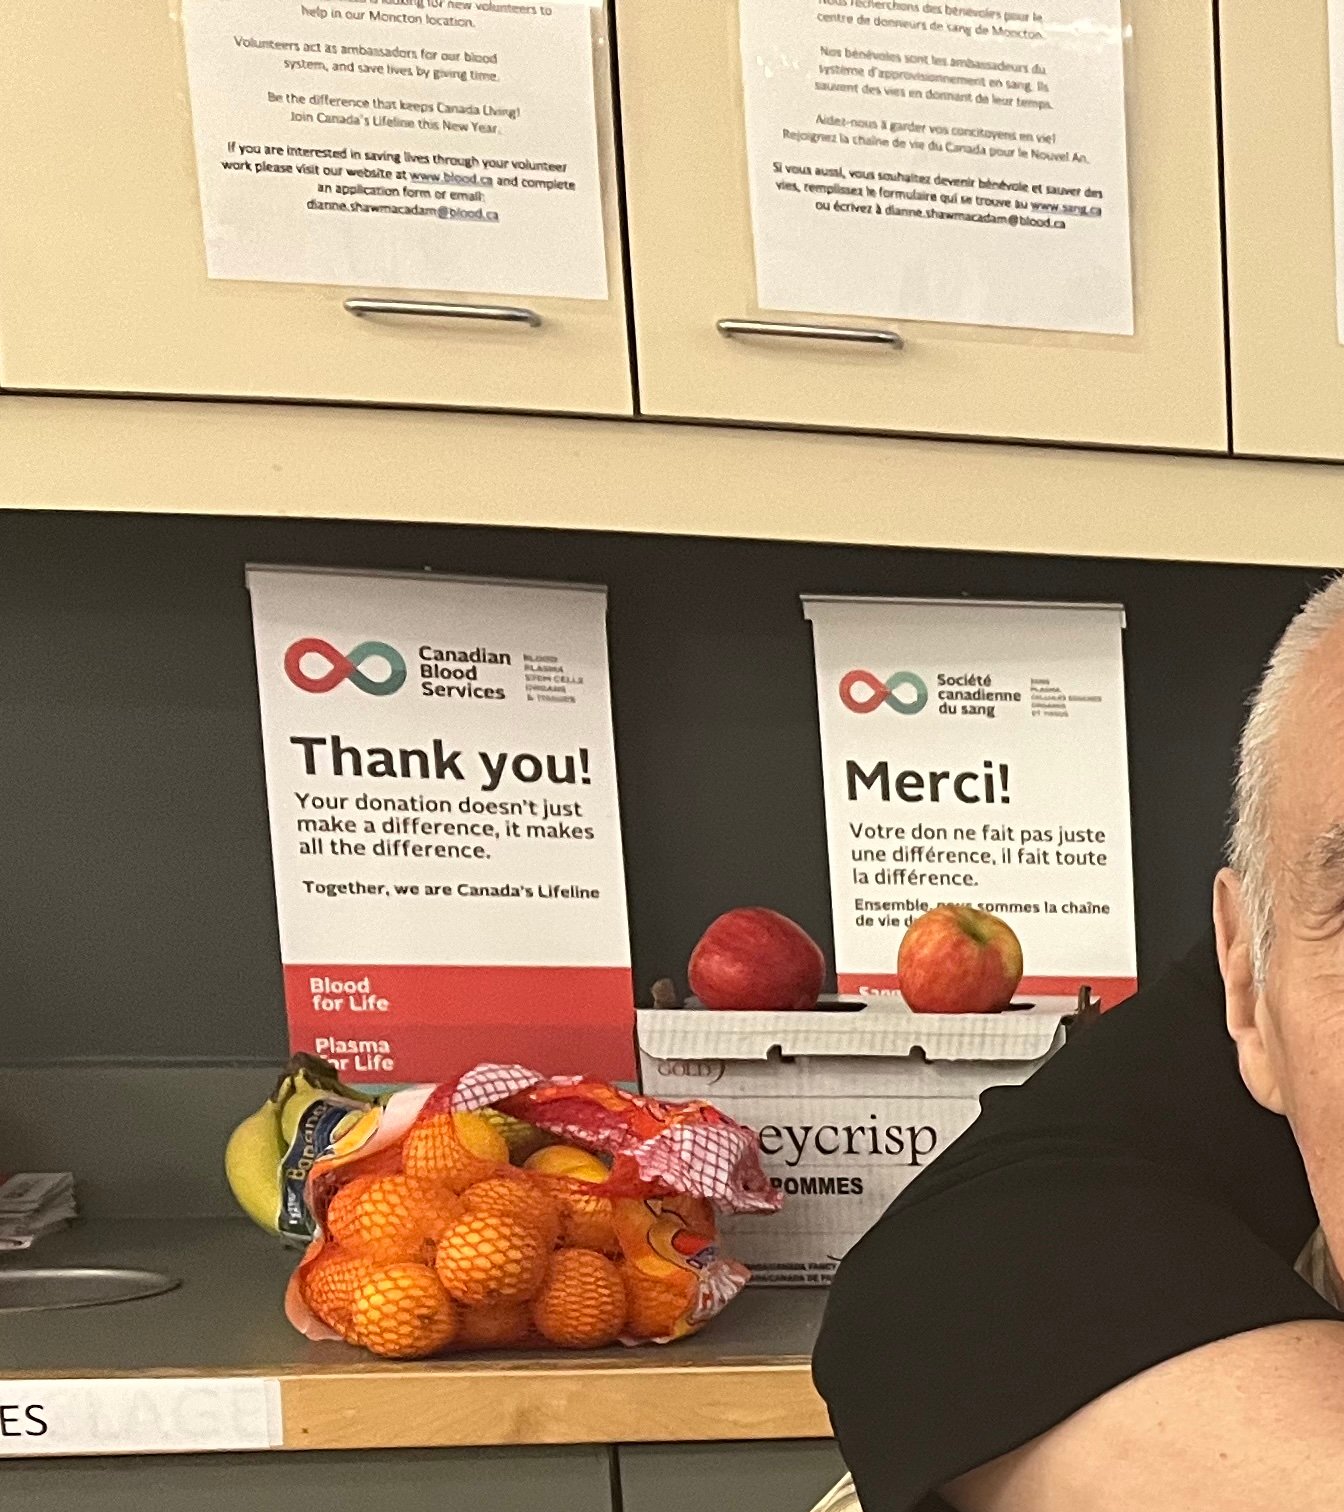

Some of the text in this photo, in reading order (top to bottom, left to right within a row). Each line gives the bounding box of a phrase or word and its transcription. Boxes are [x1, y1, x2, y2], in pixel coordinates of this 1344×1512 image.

[419, 645, 511, 665] Canadian
[420, 664, 477, 681] Blood
[937, 673, 992, 687] Société
[421, 682, 506, 700] Services
[938, 688, 1022, 702] canadienne
[938, 702, 995, 718] du sang
[290, 734, 590, 791] Thank you!
[846, 759, 1011, 804] Merci!
[294, 791, 583, 820] Your donation doesn't just
[297, 815, 594, 840] make a difference, it makes
[849, 822, 1105, 846] Votre don ne fait pas juste
[299, 836, 490, 859] all the difference.
[851, 845, 1106, 866] une différence, il fait toute
[852, 867, 977, 886] la différence.
[302, 880, 599, 898] Together, we are Canada's Lifeline
[977, 902, 1040, 913] sommes
[1044, 900, 1057, 913] la
[1061, 901, 1110, 914] chaîne
[856, 915, 874, 927] de
[878, 915, 900, 927] vie
[310, 977, 370, 994] Blood
[312, 995, 389, 1012] for Life
[315, 1037, 390, 1054] Plasma
[355, 1055, 394, 1072] Life
[759, 1114, 938, 1166] eycrisp
[0, 1404, 48, 1436] ES
